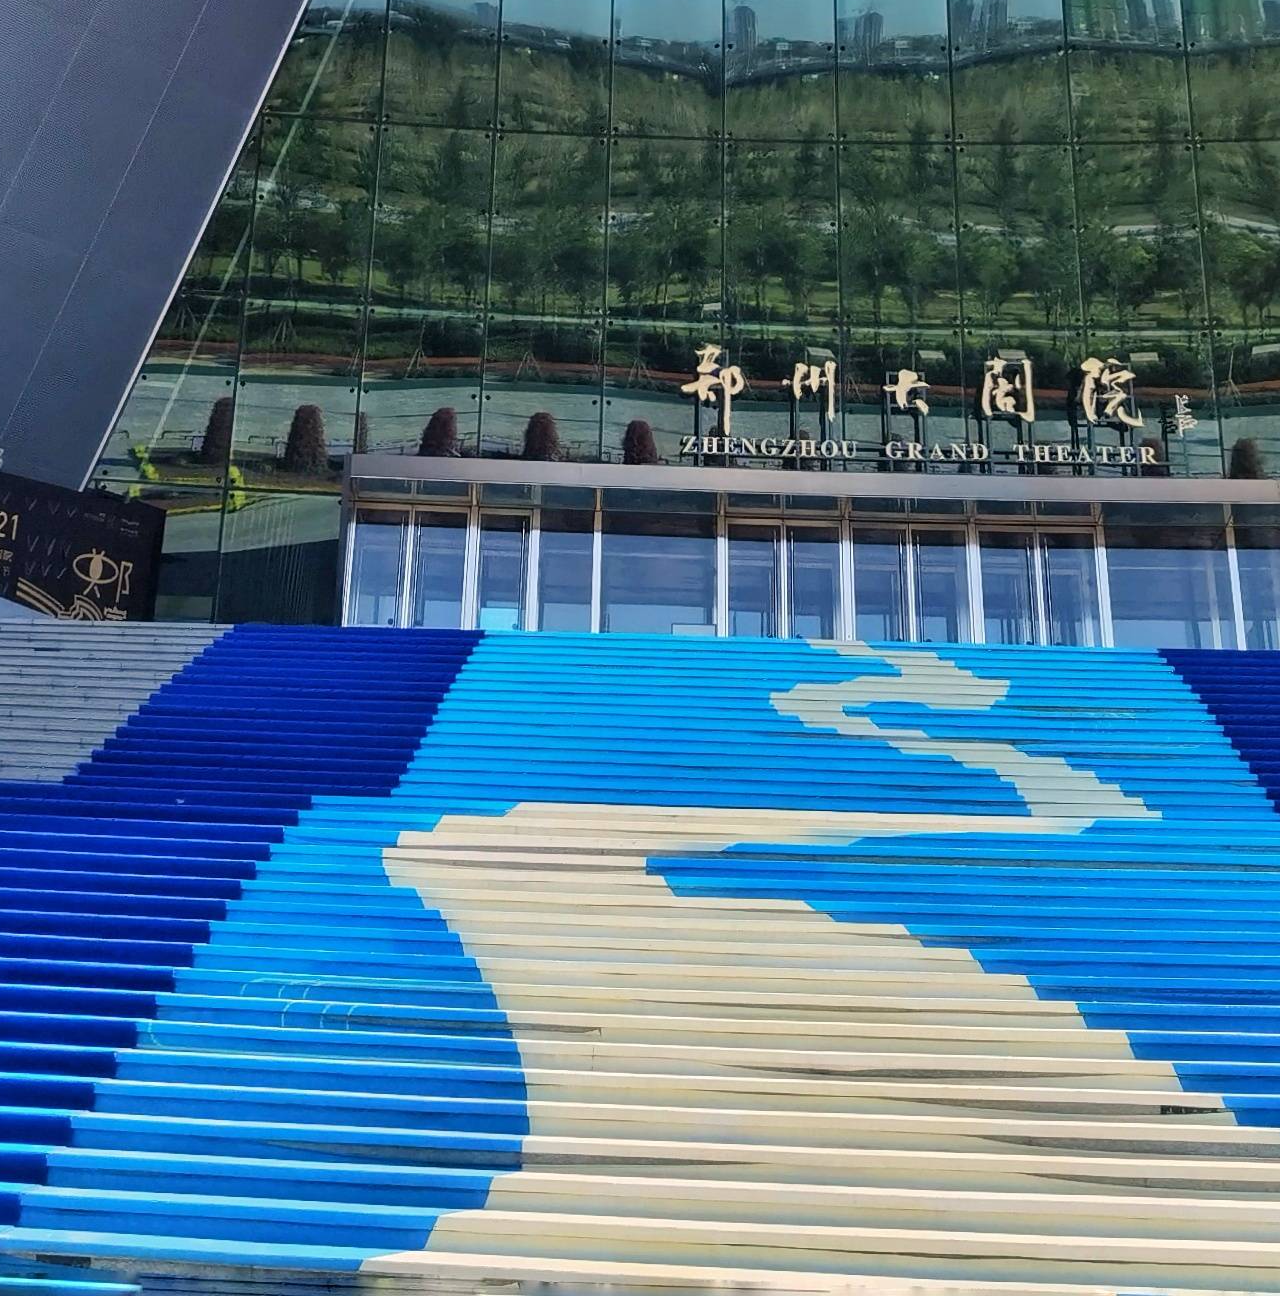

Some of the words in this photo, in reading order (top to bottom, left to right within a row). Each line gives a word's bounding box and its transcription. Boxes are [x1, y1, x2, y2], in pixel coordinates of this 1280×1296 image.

[681, 436, 858, 459] ZHENGZHOU
[885, 442, 989, 461] GRAND
[1013, 444, 1160, 465] THEATER
